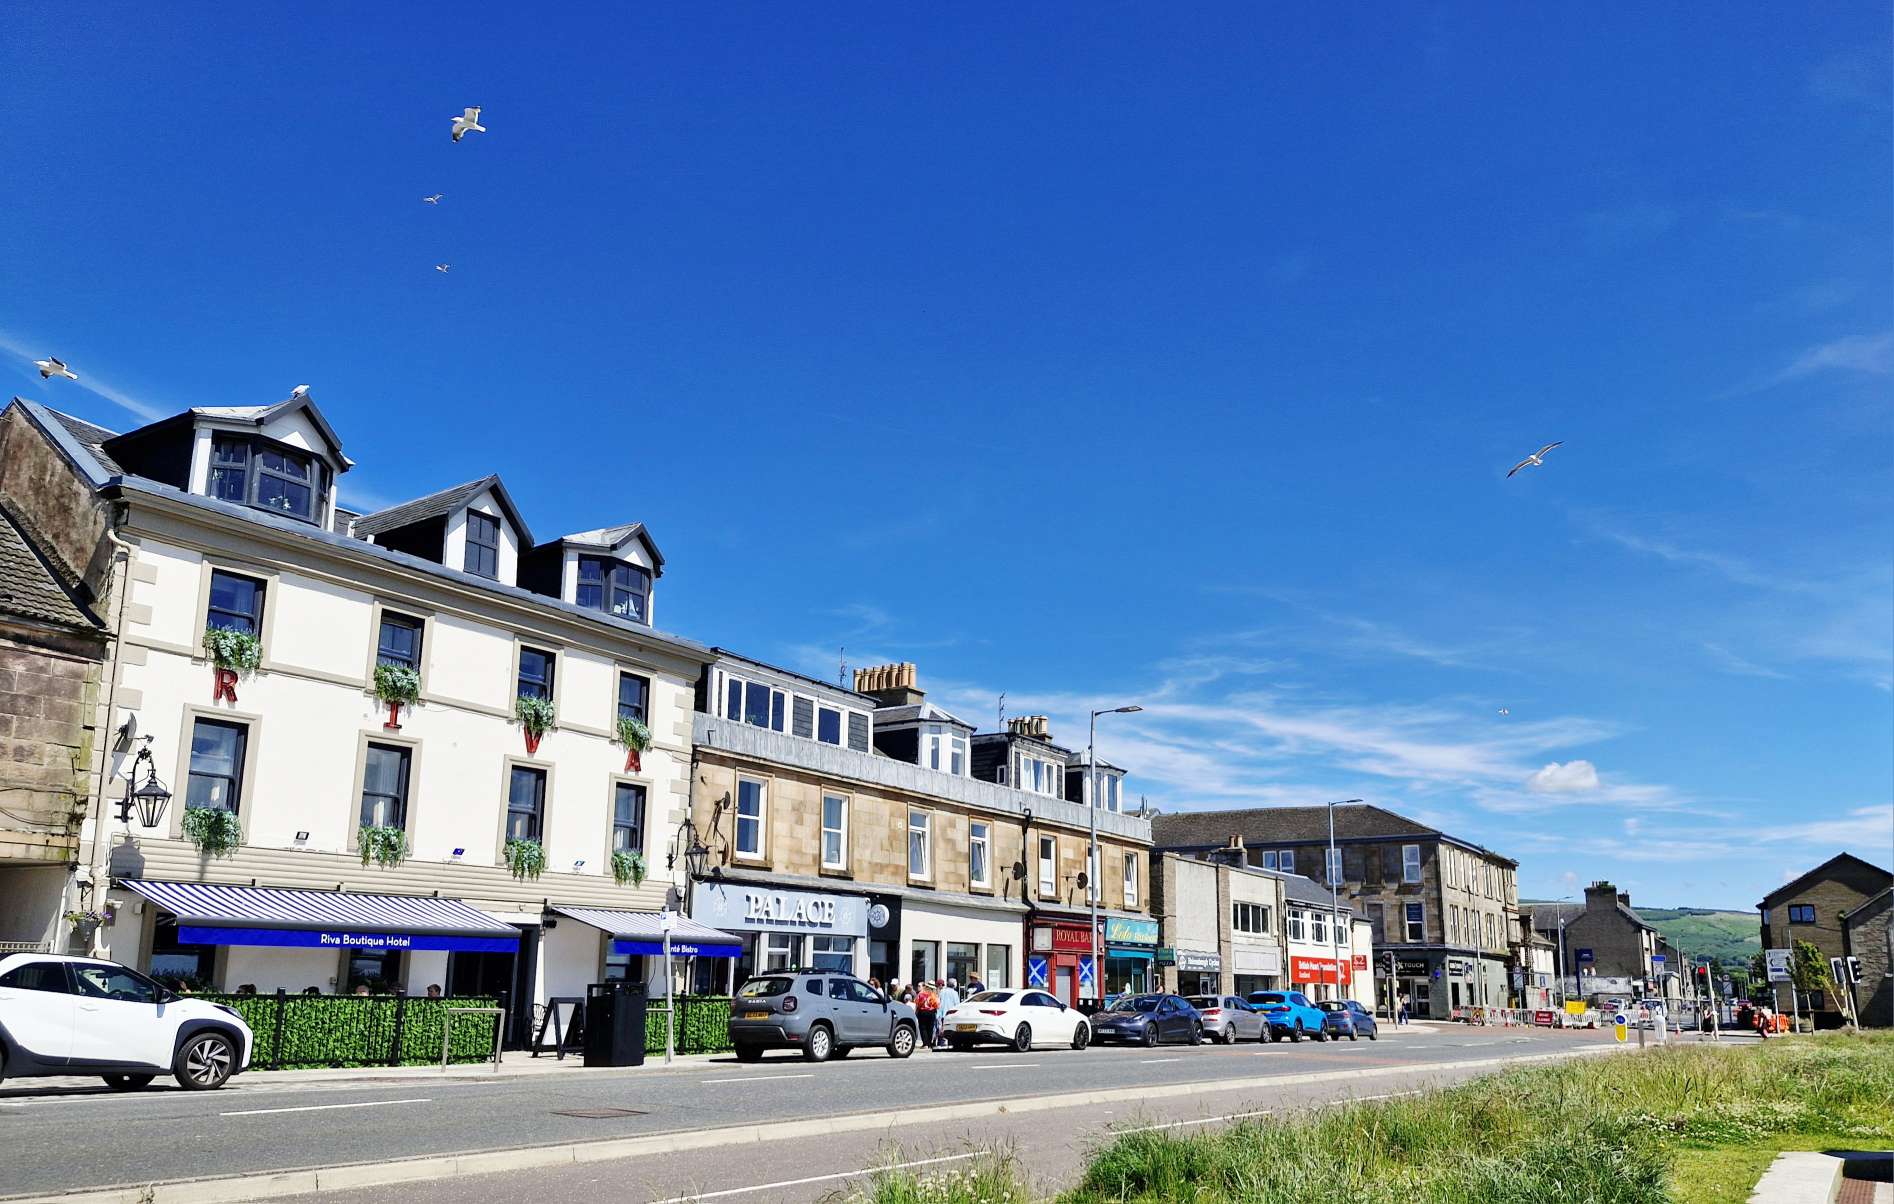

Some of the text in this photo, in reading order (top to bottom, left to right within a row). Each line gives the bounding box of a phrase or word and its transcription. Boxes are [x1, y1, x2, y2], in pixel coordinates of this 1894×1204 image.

[747, 893, 836, 924] PALACE
[320, 934, 410, 947] Riva Boutique Hotel
[1056, 929, 1080, 942] ROYAL
[681, 944, 698, 953] Bistro
